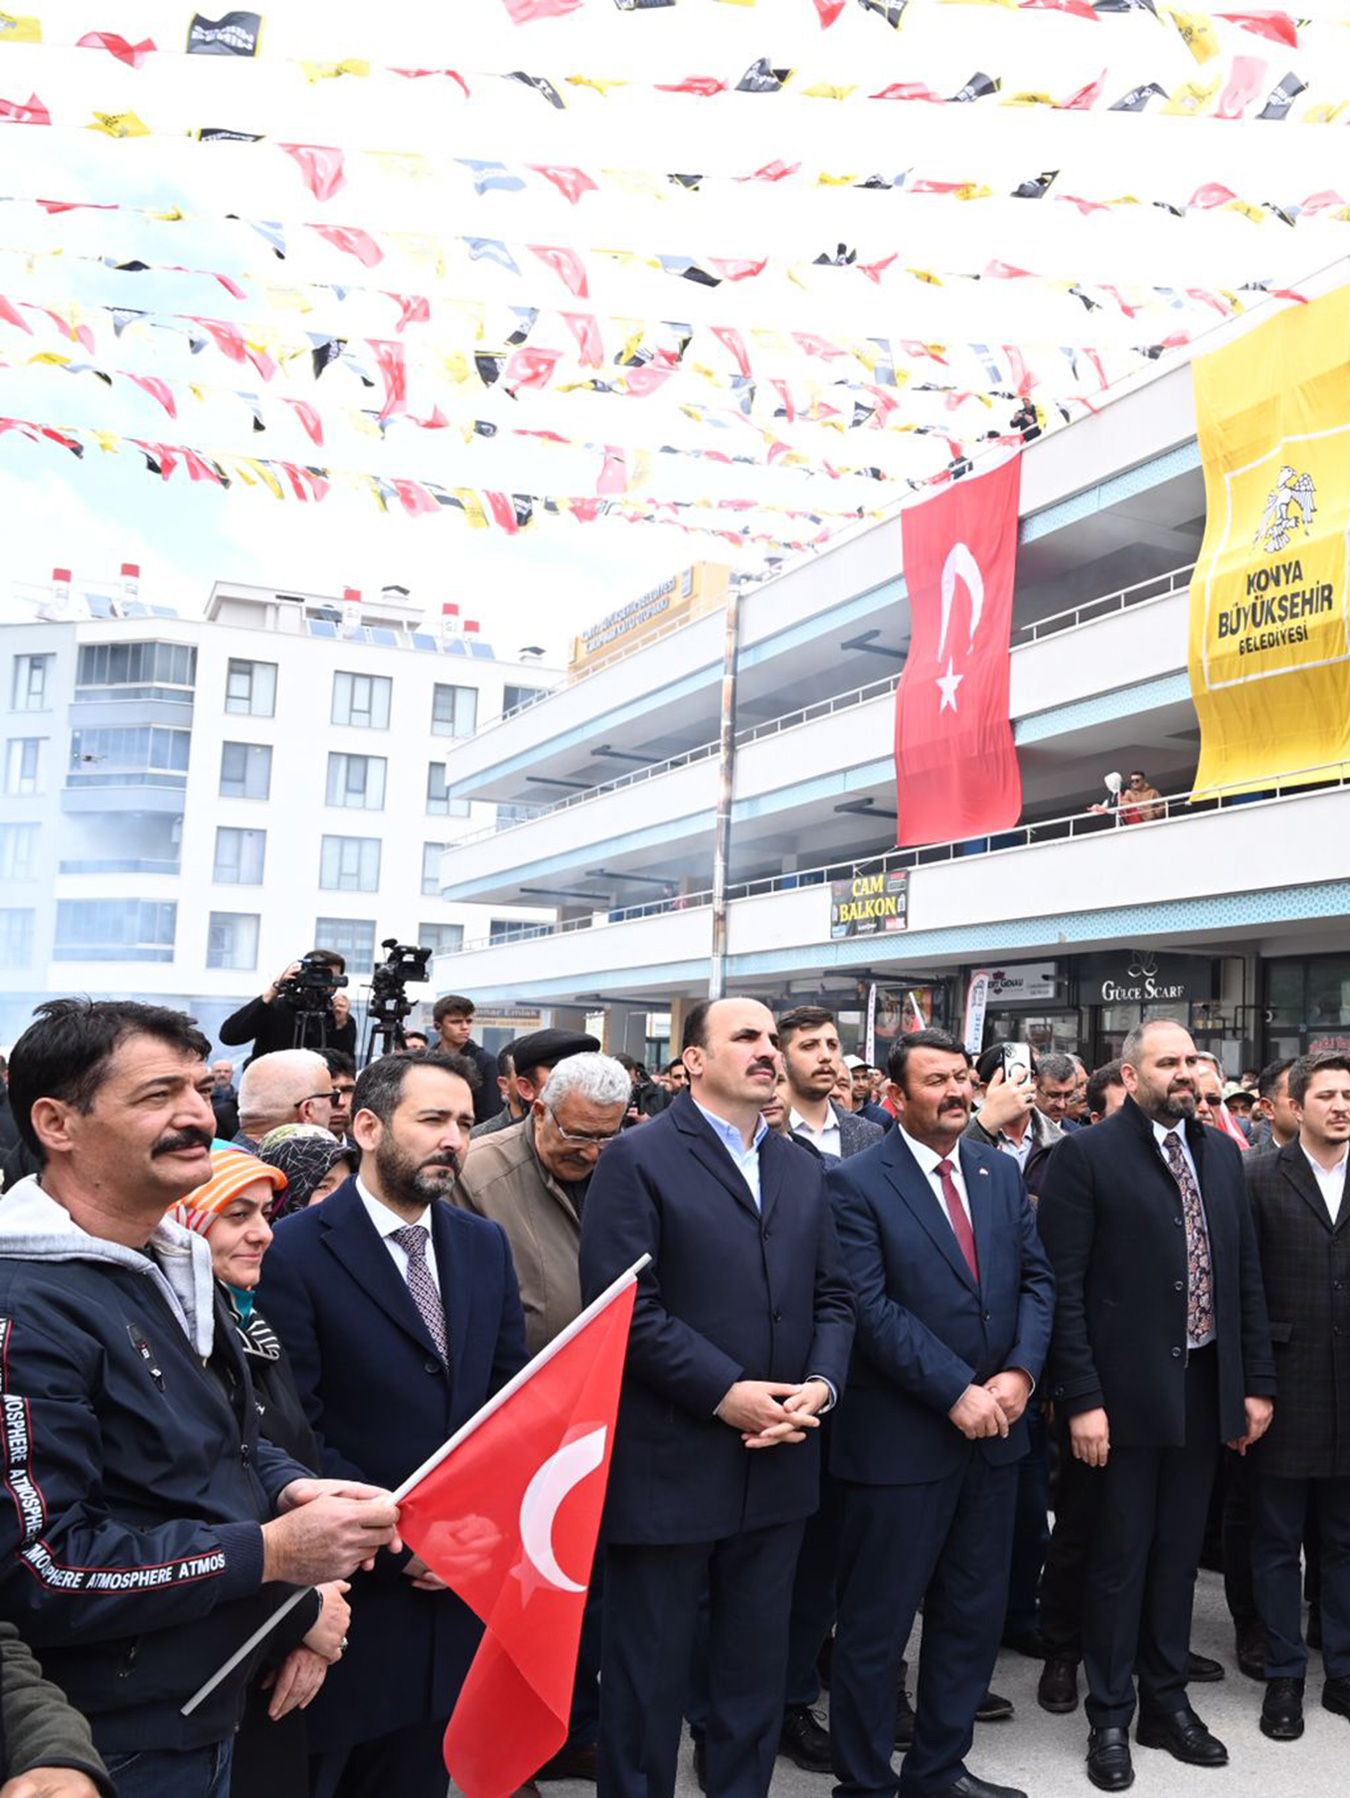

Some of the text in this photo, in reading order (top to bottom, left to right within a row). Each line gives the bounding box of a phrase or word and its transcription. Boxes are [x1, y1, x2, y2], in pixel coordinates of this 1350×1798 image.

[1247, 560, 1303, 596] KONYA
[1218, 580, 1334, 638] BÜYÜKŞEHİR
[852, 874, 884, 897] CAM
[839, 896, 896, 923] BALKON
[86, 1566, 173, 1589] ATMOSPHERE
[178, 1552, 225, 1578] ATMOS
